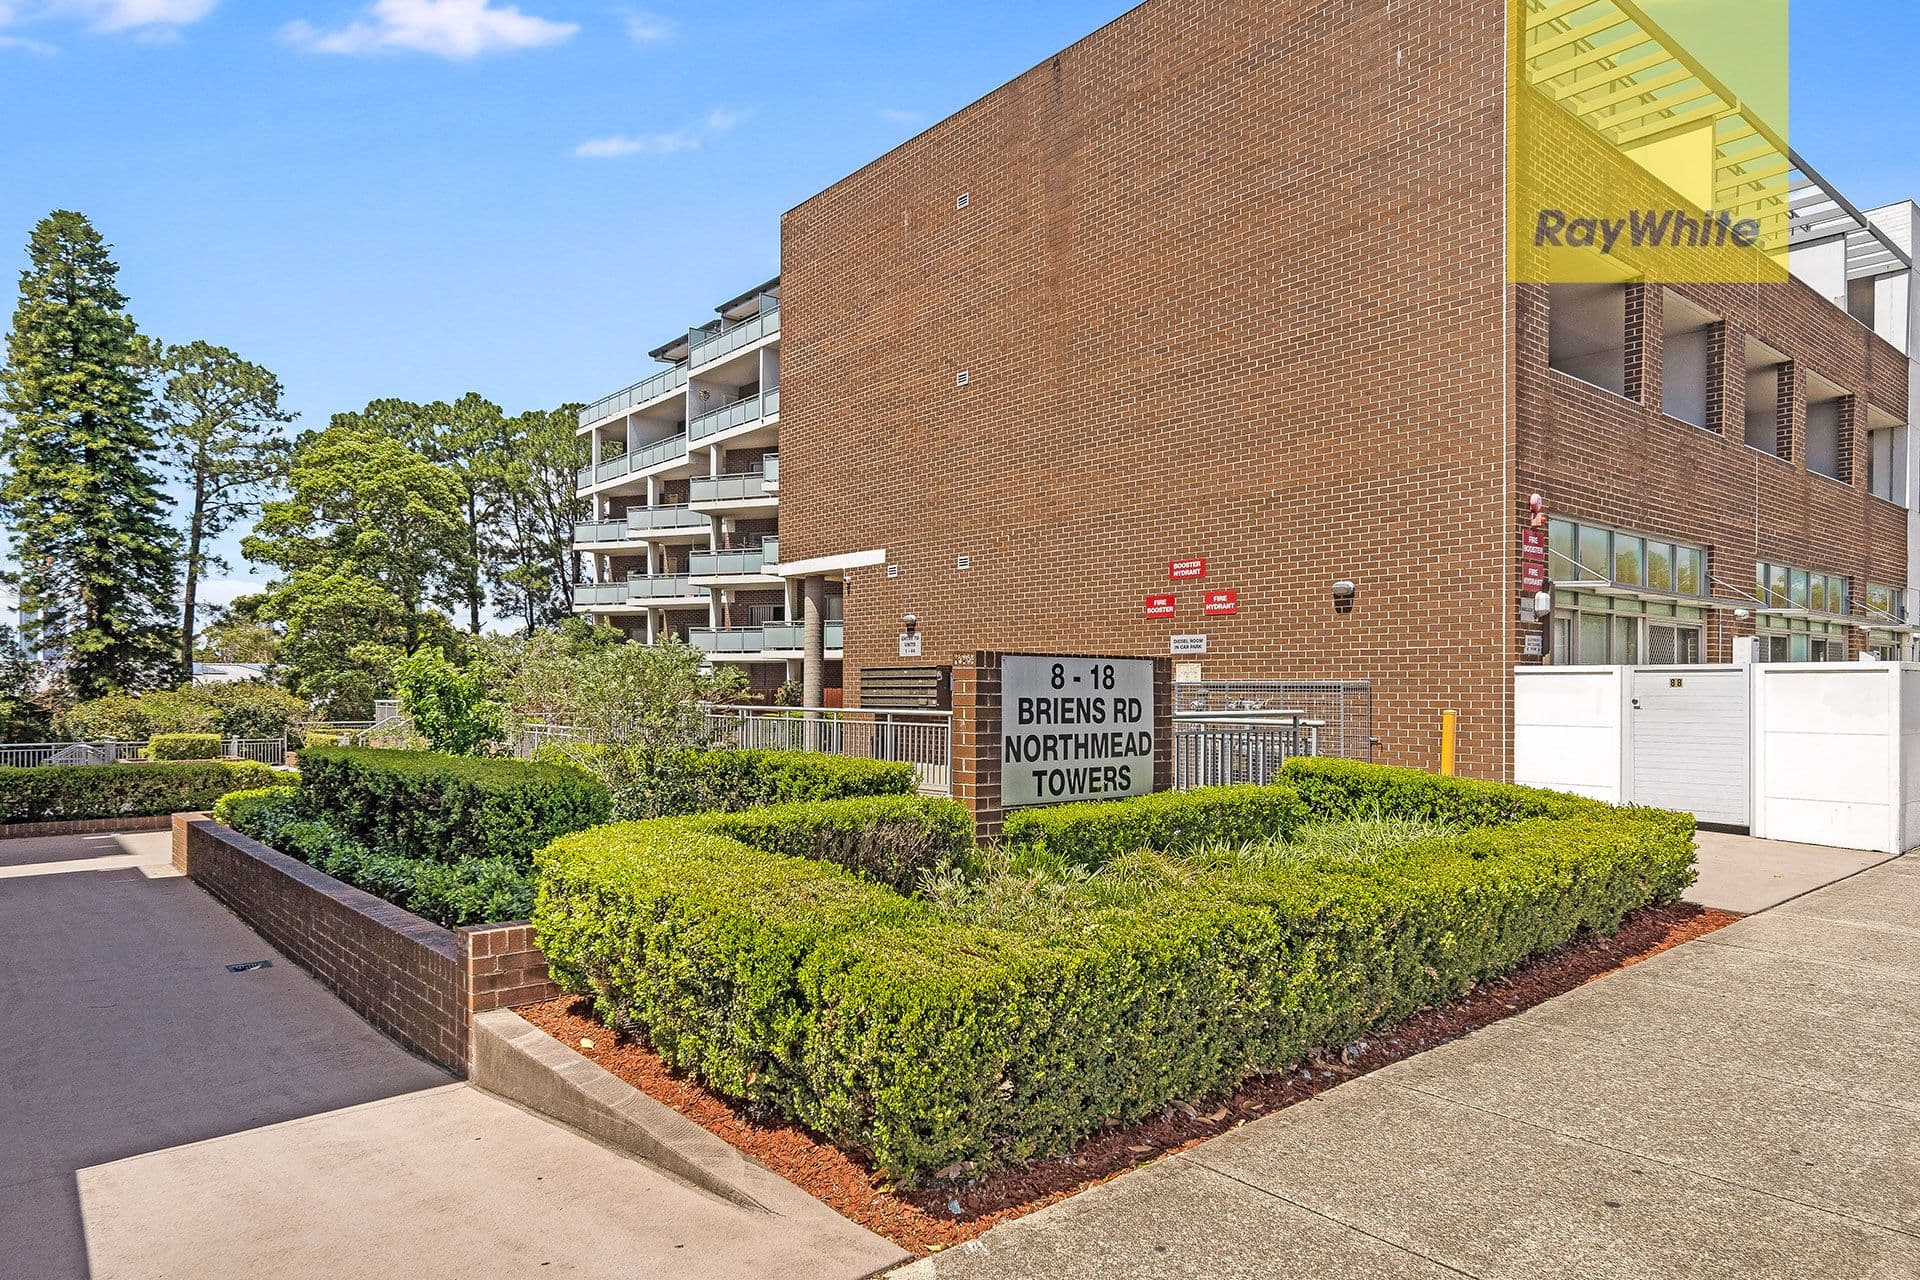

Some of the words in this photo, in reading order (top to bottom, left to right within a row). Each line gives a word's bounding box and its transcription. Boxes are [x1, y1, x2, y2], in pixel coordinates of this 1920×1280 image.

[1528, 536, 1538, 544] FIRE
[1524, 545, 1543, 554] BOOSTER
[1173, 561, 1201, 569] BOOSTER
[1173, 568, 1201, 577] HYDRANT
[1528, 568, 1538, 576] FIRE
[1524, 577, 1543, 586] HYDRANT
[1051, 663, 1065, 689] 8
[1090, 664, 1115, 690] 18
[1018, 697, 1106, 725] BRIENS
[1113, 698, 1142, 723] RD
[1005, 731, 1152, 763] NORTHMEAD
[1032, 765, 1132, 797] TOWERS
